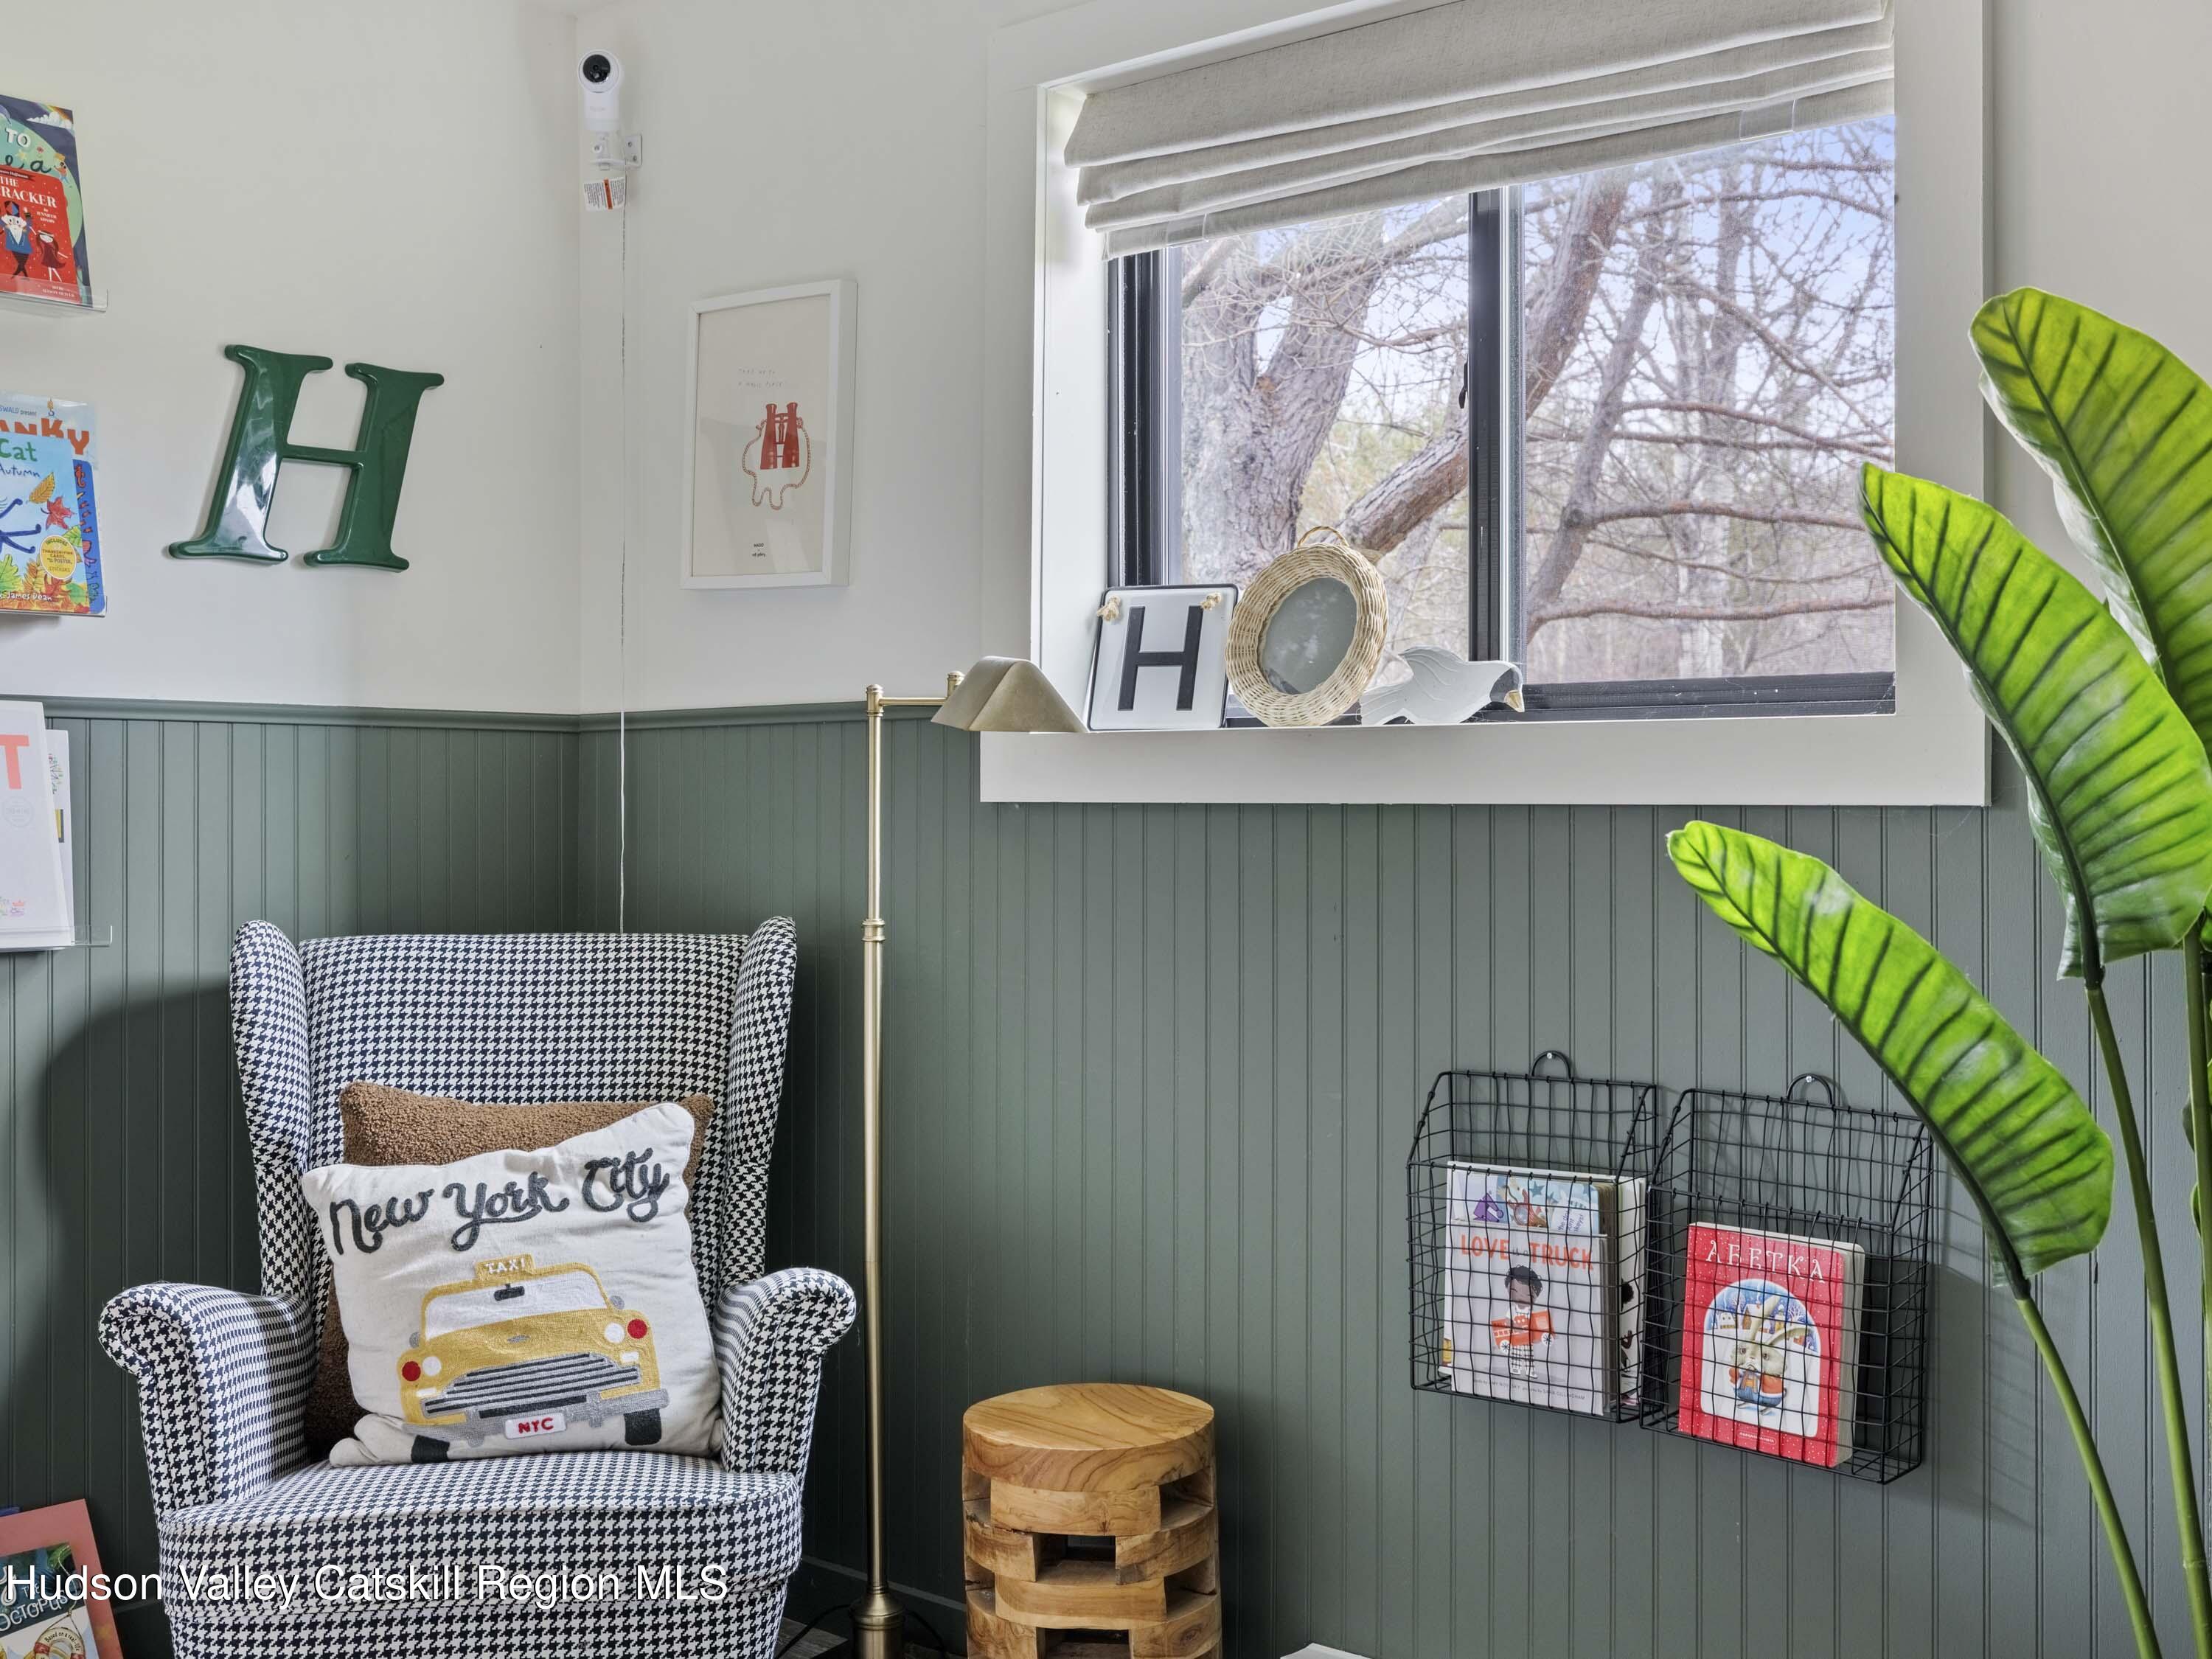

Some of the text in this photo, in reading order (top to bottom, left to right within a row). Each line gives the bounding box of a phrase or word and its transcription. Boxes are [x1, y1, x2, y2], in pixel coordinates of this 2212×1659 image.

[5, 128, 30, 148] TO
[0, 438, 38, 462] Cat
[169, 344, 445, 572] H
[1118, 606, 1204, 711] H
[330, 1147, 670, 1256] New York City
[484, 1259, 526, 1275] TAXI
[1461, 1234, 1510, 1260] LOVE
[1529, 1242, 1594, 1270] TRUCK
[518, 1418, 554, 1433] NYC
